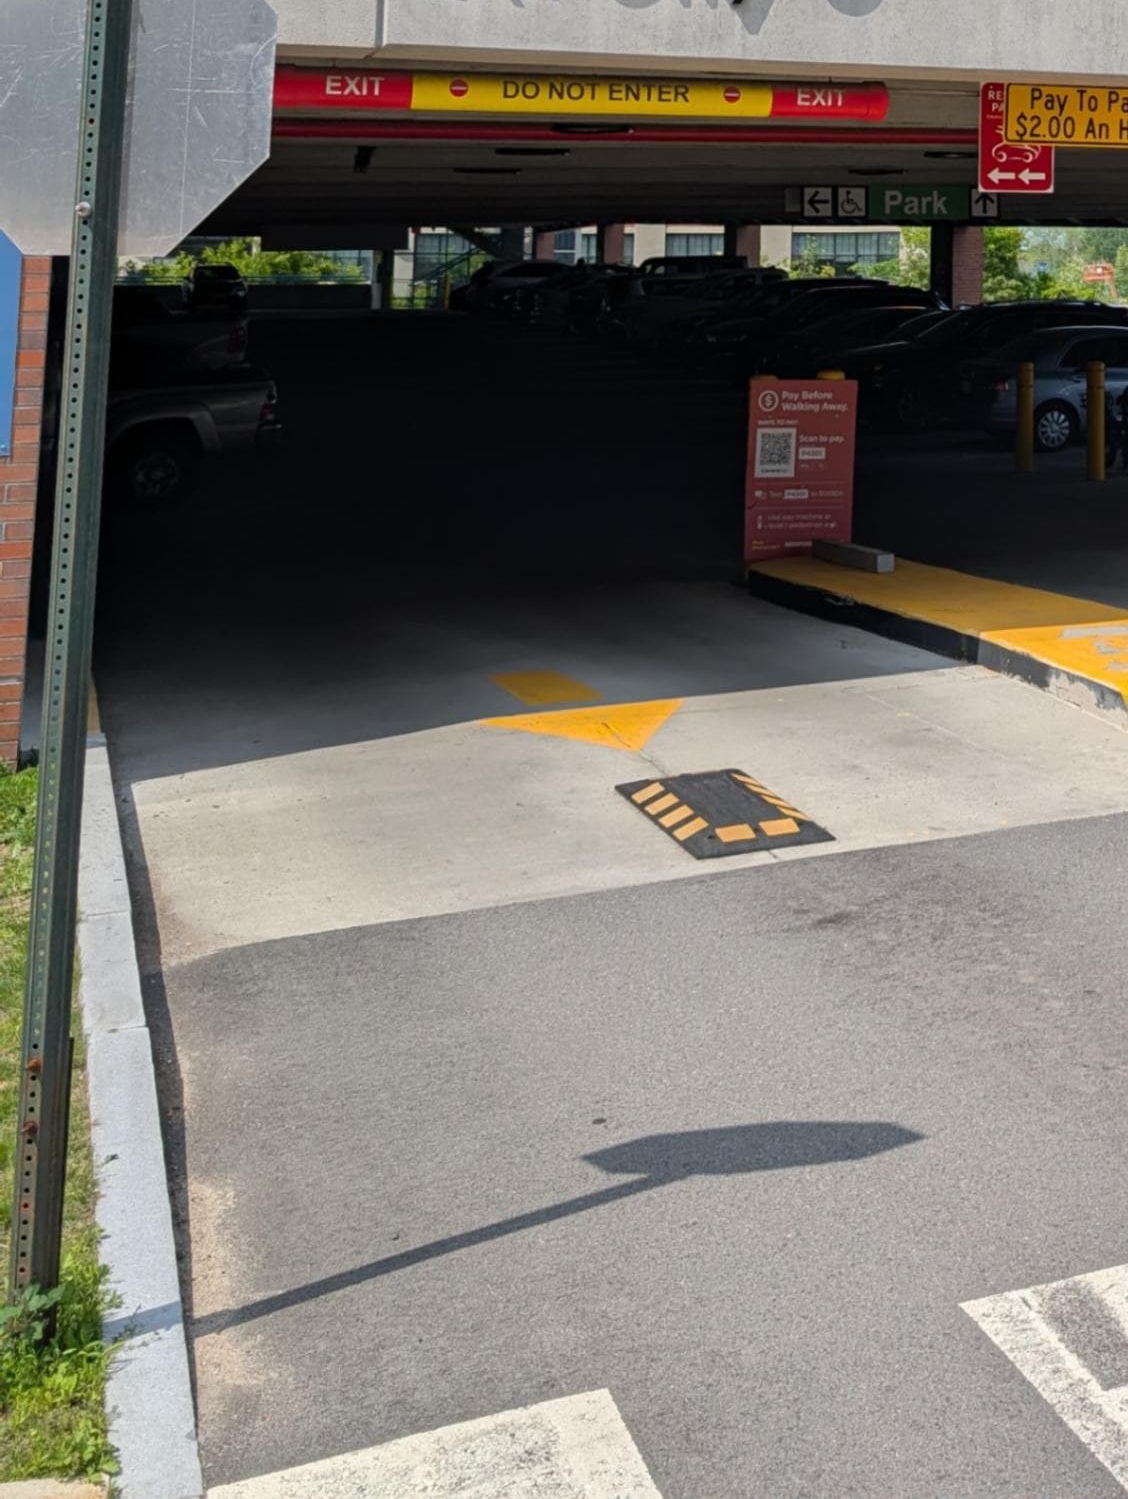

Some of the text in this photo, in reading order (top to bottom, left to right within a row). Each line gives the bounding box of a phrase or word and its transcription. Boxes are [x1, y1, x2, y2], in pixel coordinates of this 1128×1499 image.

[323, 75, 385, 97] EXIT
[501, 79, 690, 103] DO NOT ENTER
[796, 87, 845, 108] EXIT
[1030, 87, 1064, 117] Pay
[1076, 89, 1098, 113] To
[1015, 115, 1075, 141] $2.00
[1084, 117, 1110, 141] An
[884, 190, 948, 215] Park
[782, 390, 833, 401] Pay Before
[782, 402, 848, 412] Walking Away.
[799, 434, 818, 443] Scan
[819, 434, 828, 443] to
